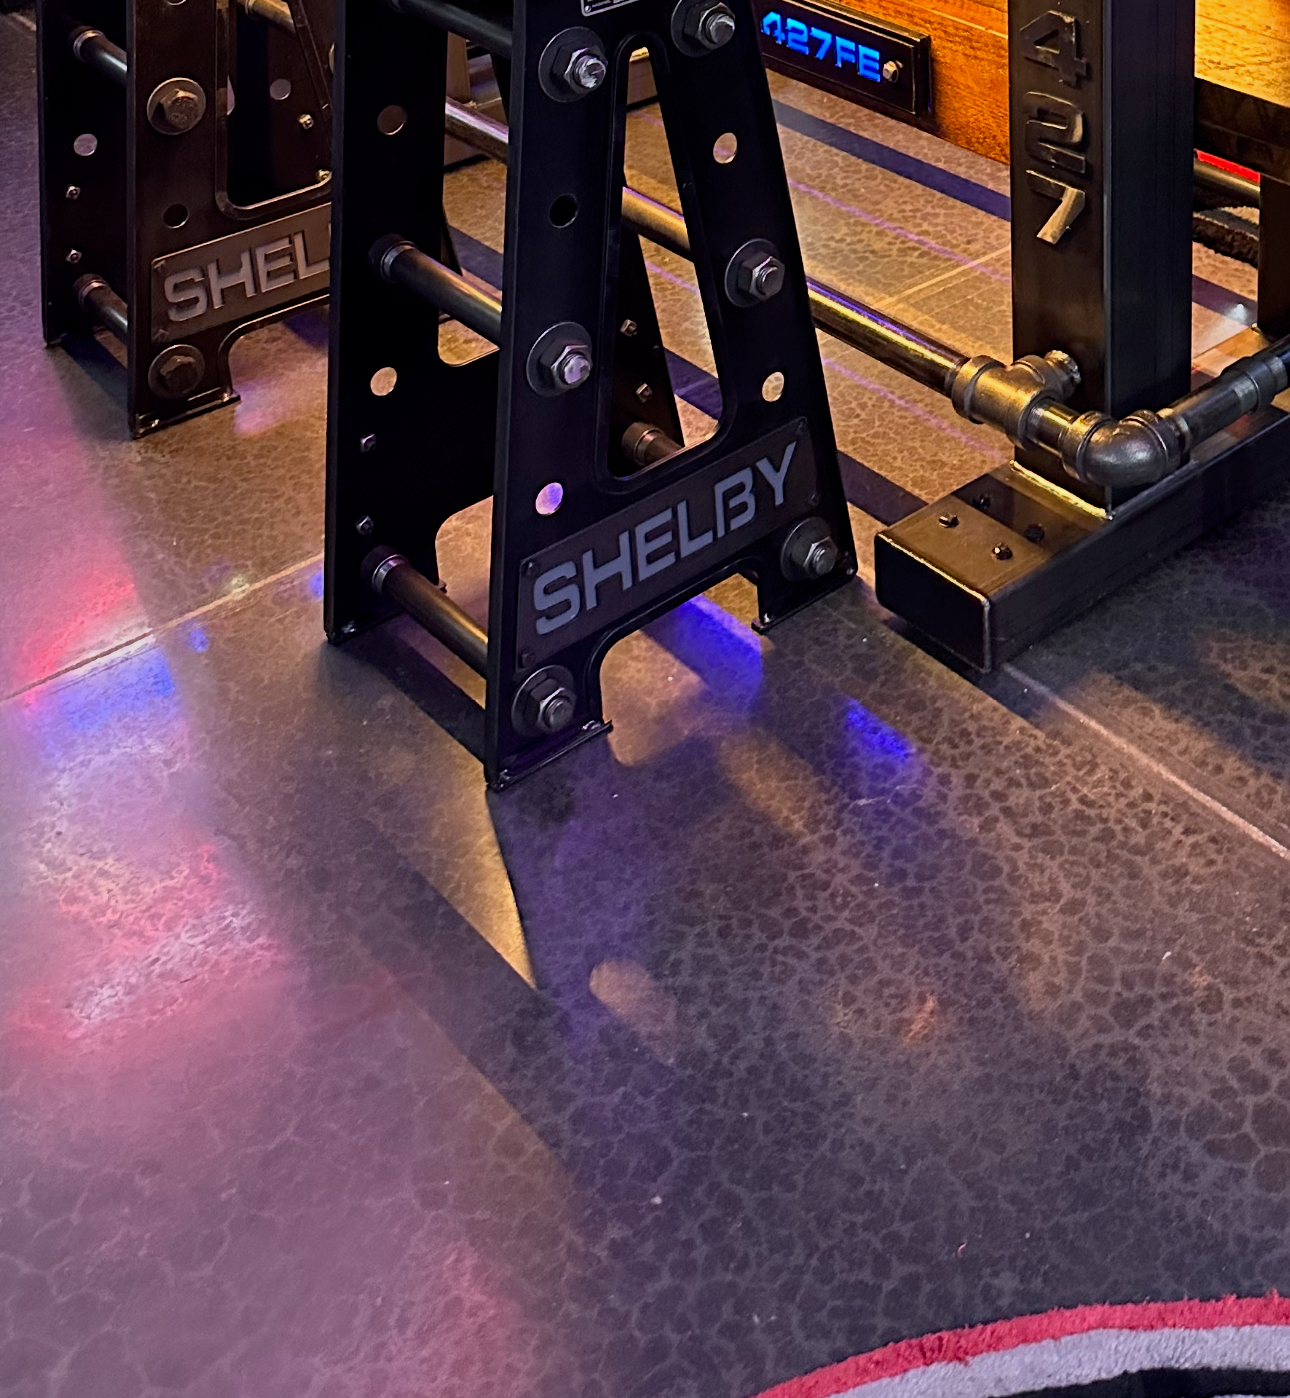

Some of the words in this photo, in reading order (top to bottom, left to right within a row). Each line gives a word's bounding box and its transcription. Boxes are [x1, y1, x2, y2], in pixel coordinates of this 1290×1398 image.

[760, 11, 881, 83] 427FE
[1019, 10, 1087, 244] 427
[532, 440, 797, 635] SHELBY
